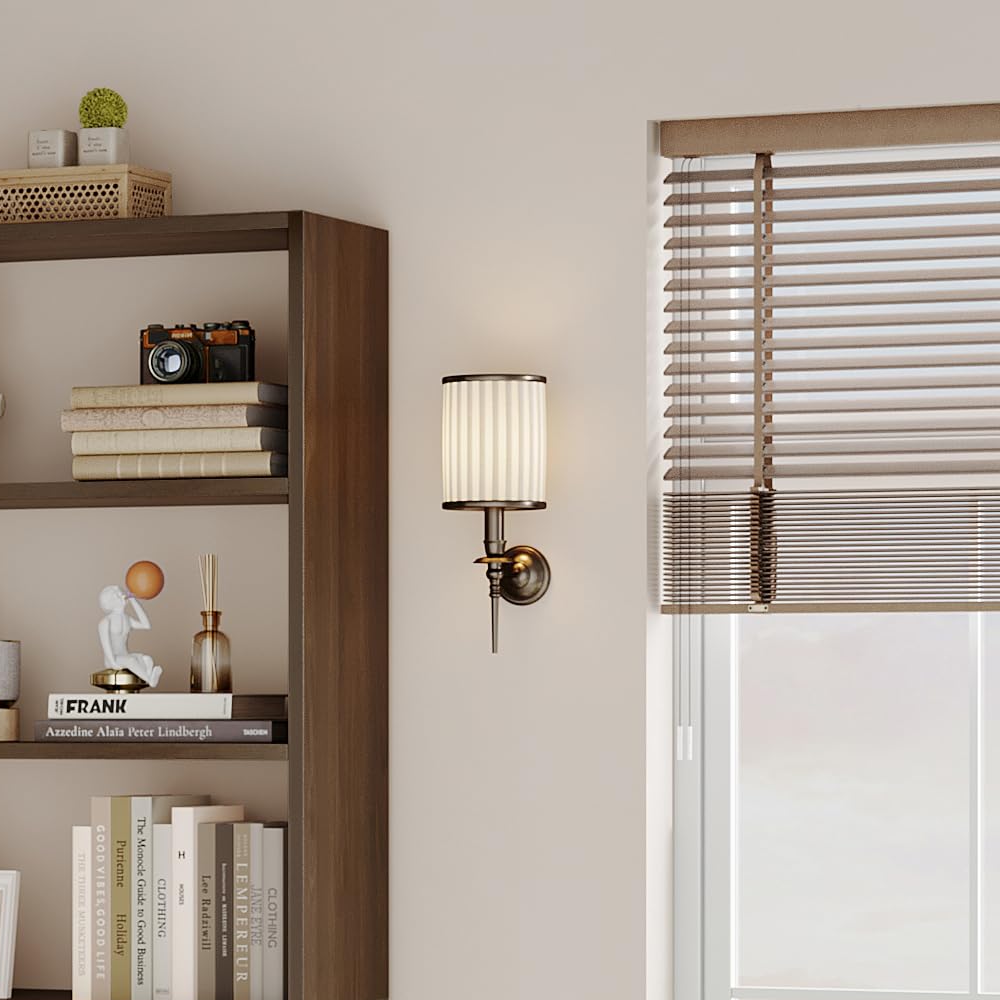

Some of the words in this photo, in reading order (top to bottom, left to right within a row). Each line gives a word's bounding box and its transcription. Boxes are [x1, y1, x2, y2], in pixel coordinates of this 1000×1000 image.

[66, 699, 127, 714] FRANK
[45, 725, 94, 737] Azzedine
[128, 726, 155, 737] Peter
[158, 725, 213, 741] Lindbergh
[96, 824, 105, 863] GOOD
[137, 817, 146, 835] The
[116, 840, 127, 888] Purienne
[137, 838, 146, 876] Monocle
[137, 878, 146, 906] Guide
[201, 875, 211, 894] Lee
[137, 908, 144, 918] to
[157, 878, 167, 938] CLOTHING
[201, 898, 211, 951] Radziwill
[236, 863, 248, 982] LEMPEREUR
[267, 887, 277, 949] CLOTHING
[113, 914, 127, 957] Holiday
[137, 920, 146, 945] Good
[96, 951, 105, 980] LIFE
[137, 948, 146, 986] Business
